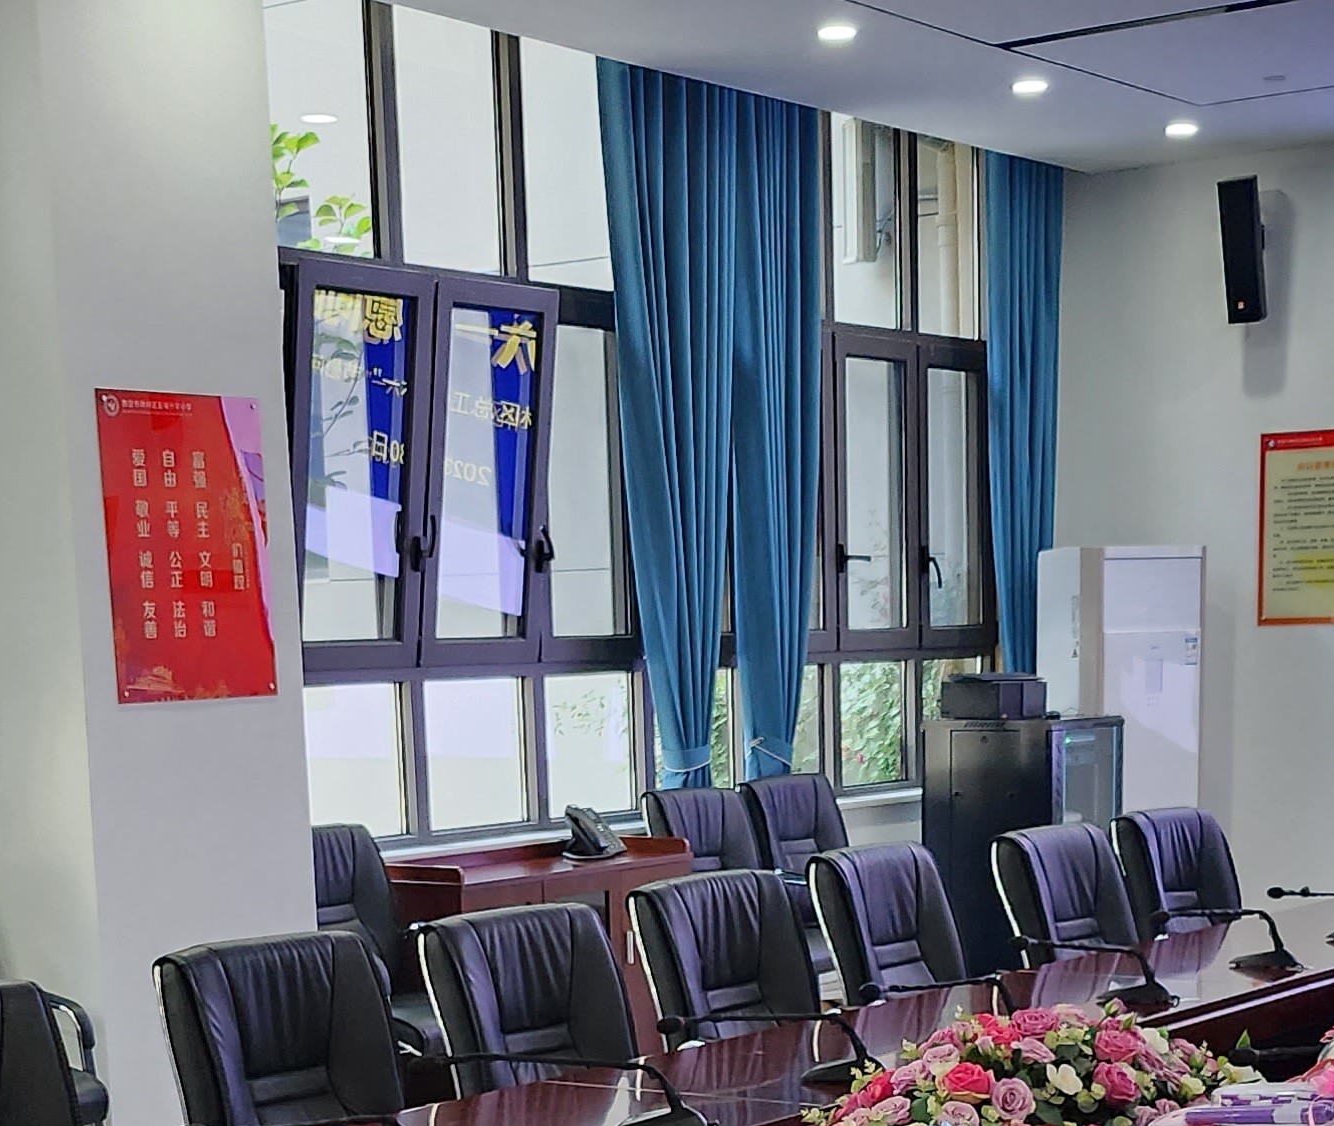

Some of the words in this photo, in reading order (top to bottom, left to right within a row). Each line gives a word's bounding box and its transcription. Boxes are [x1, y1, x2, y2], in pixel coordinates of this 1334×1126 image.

[132, 449, 147, 487] 爱国
[162, 450, 177, 488] 自由
[135, 500, 150, 538] 敬业
[165, 501, 179, 538] 平等
[196, 502, 210, 538] 民主
[139, 550, 154, 589] 诚信
[169, 551, 183, 588] 公正
[199, 552, 213, 588] 文明
[143, 601, 158, 639] 友善
[173, 601, 186, 638] 法治
[201, 601, 216, 638] 和谐
